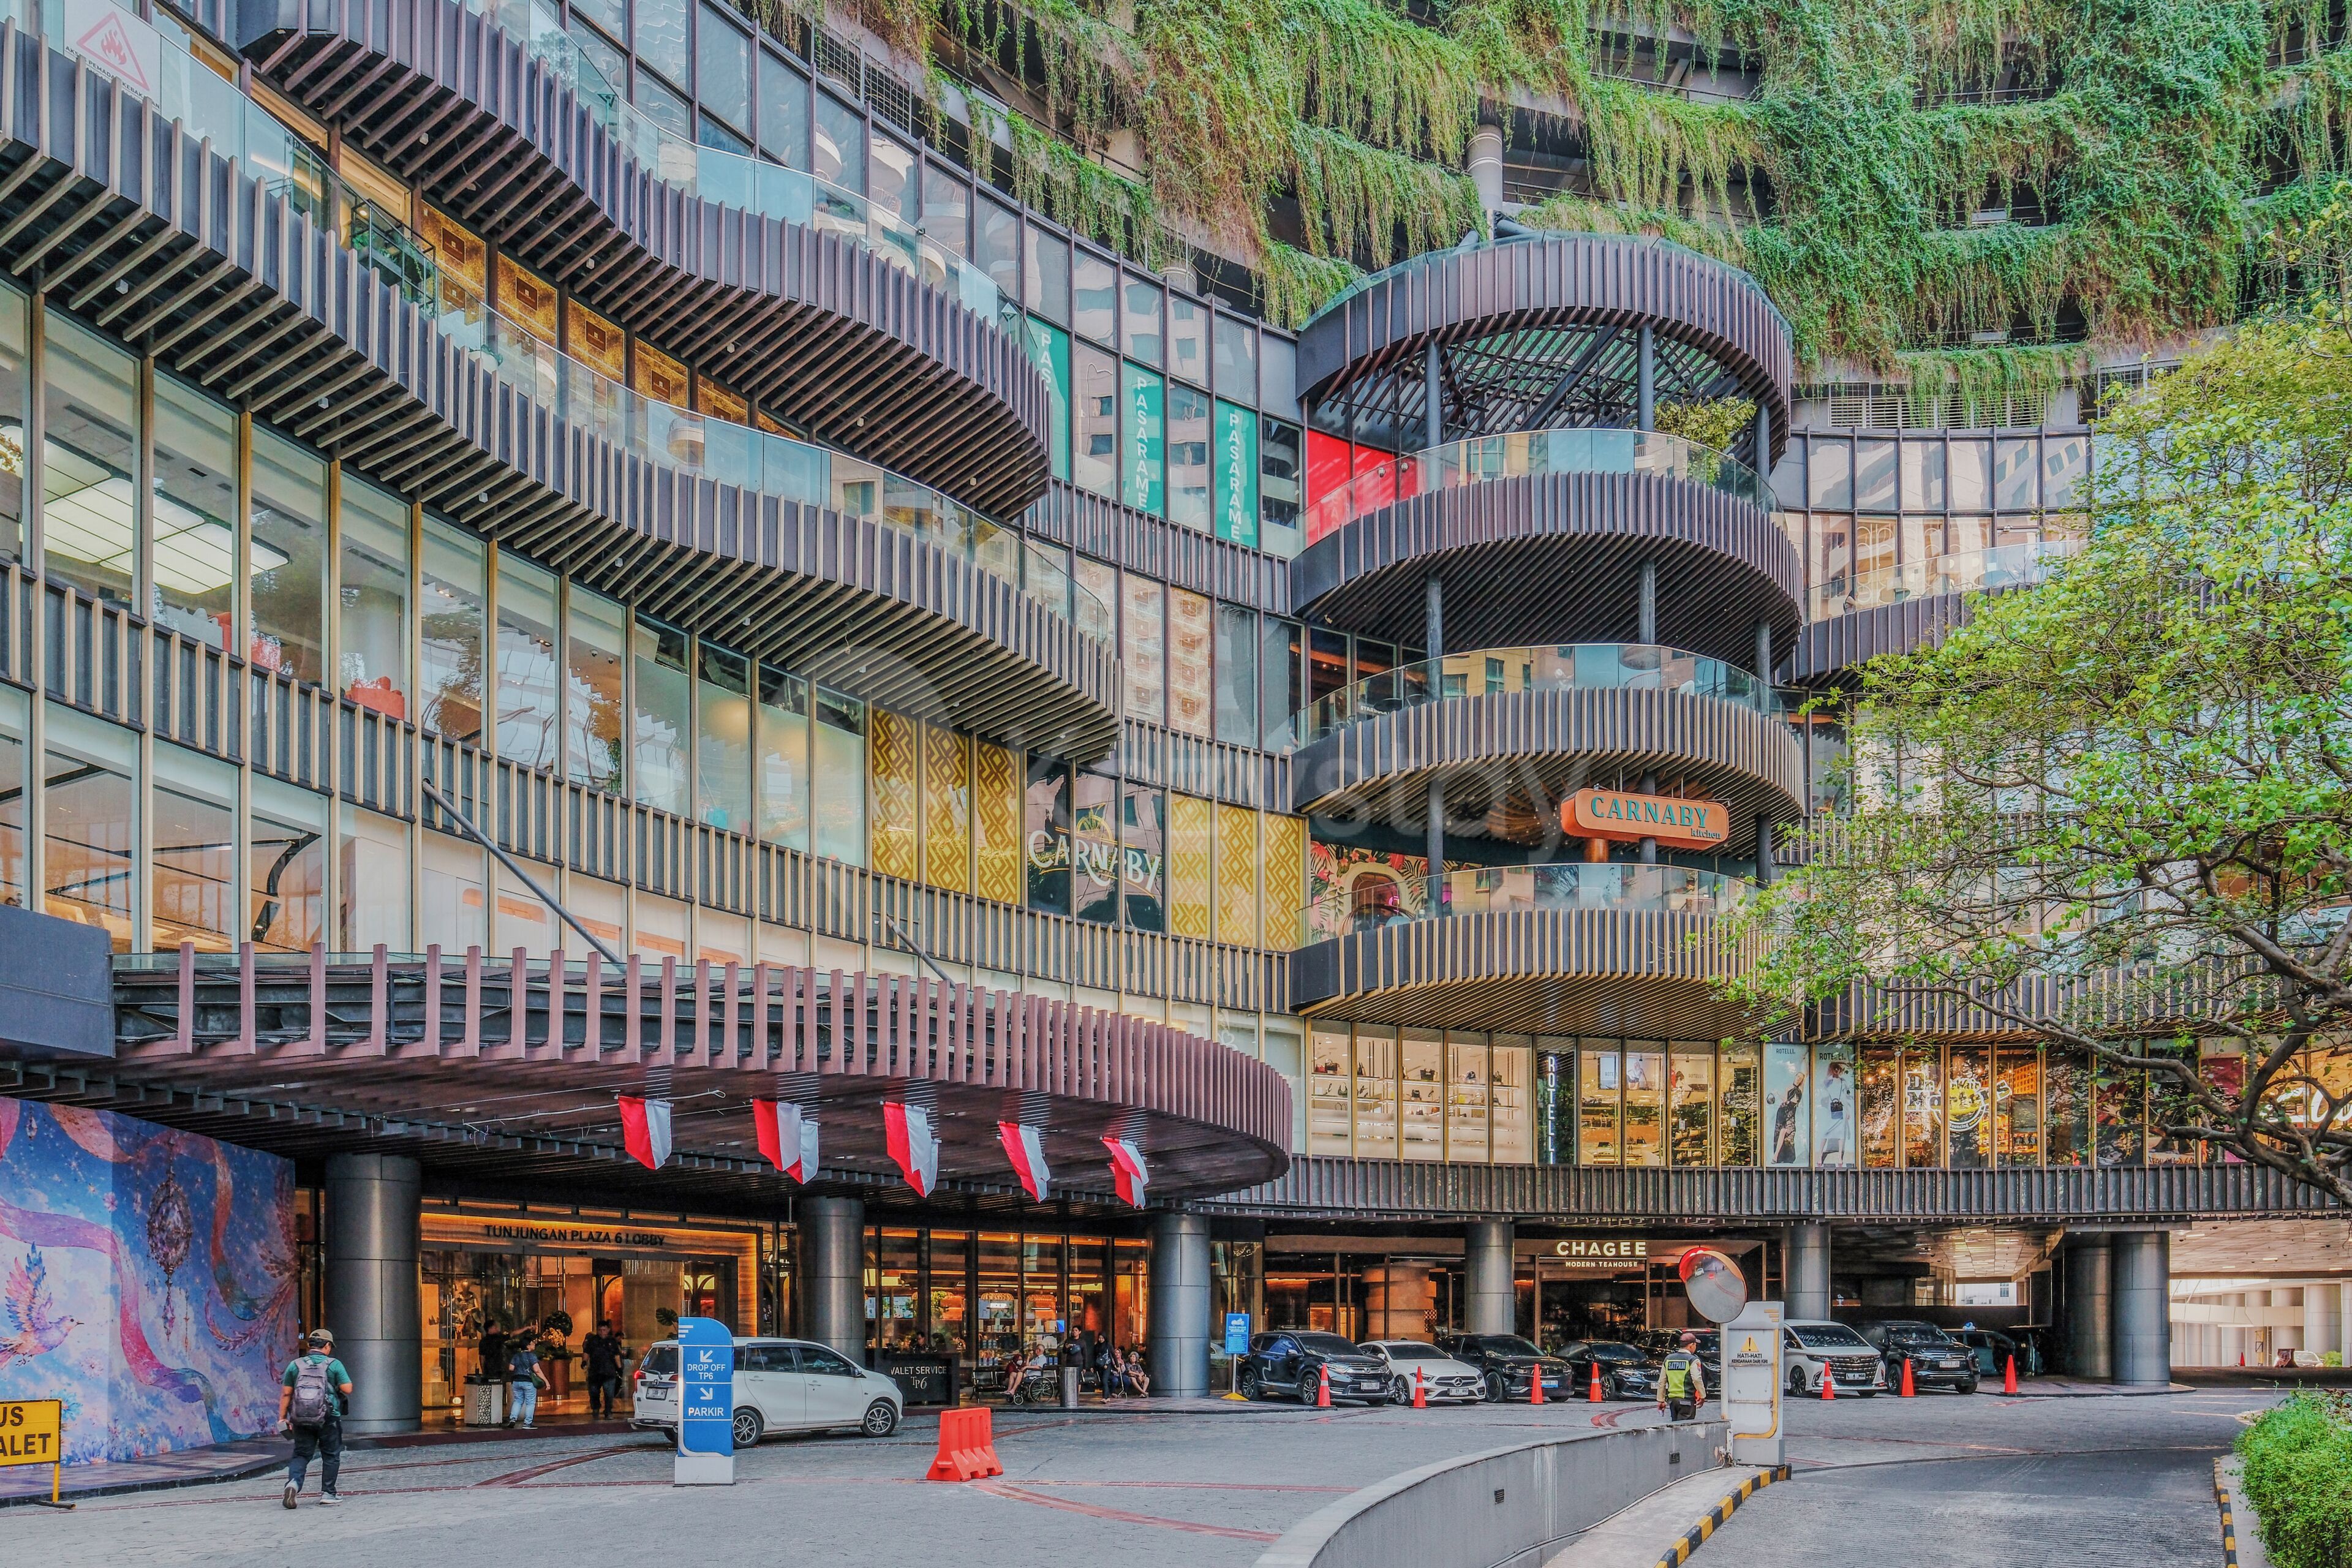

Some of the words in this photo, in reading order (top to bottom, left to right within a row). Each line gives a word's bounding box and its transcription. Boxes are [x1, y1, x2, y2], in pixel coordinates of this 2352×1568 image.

[1136, 376, 1150, 508] PASARAME
[1228, 413, 1242, 540] PASARAME
[1591, 796, 1709, 828] CARNABY
[1547, 1056, 1556, 1164] ROTELLI
[484, 1224, 567, 1242] TUNJUNGAN
[571, 1230, 611, 1243] PLAZA
[614, 1232, 622, 1244] 6
[1556, 1241, 1646, 1256] CHAGEE
[891, 1366, 914, 1375] VALET
[916, 1366, 947, 1374] SERVICE
[1668, 1361, 1686, 1370] SATPAM
[688, 1407, 724, 1417] PARKIR
